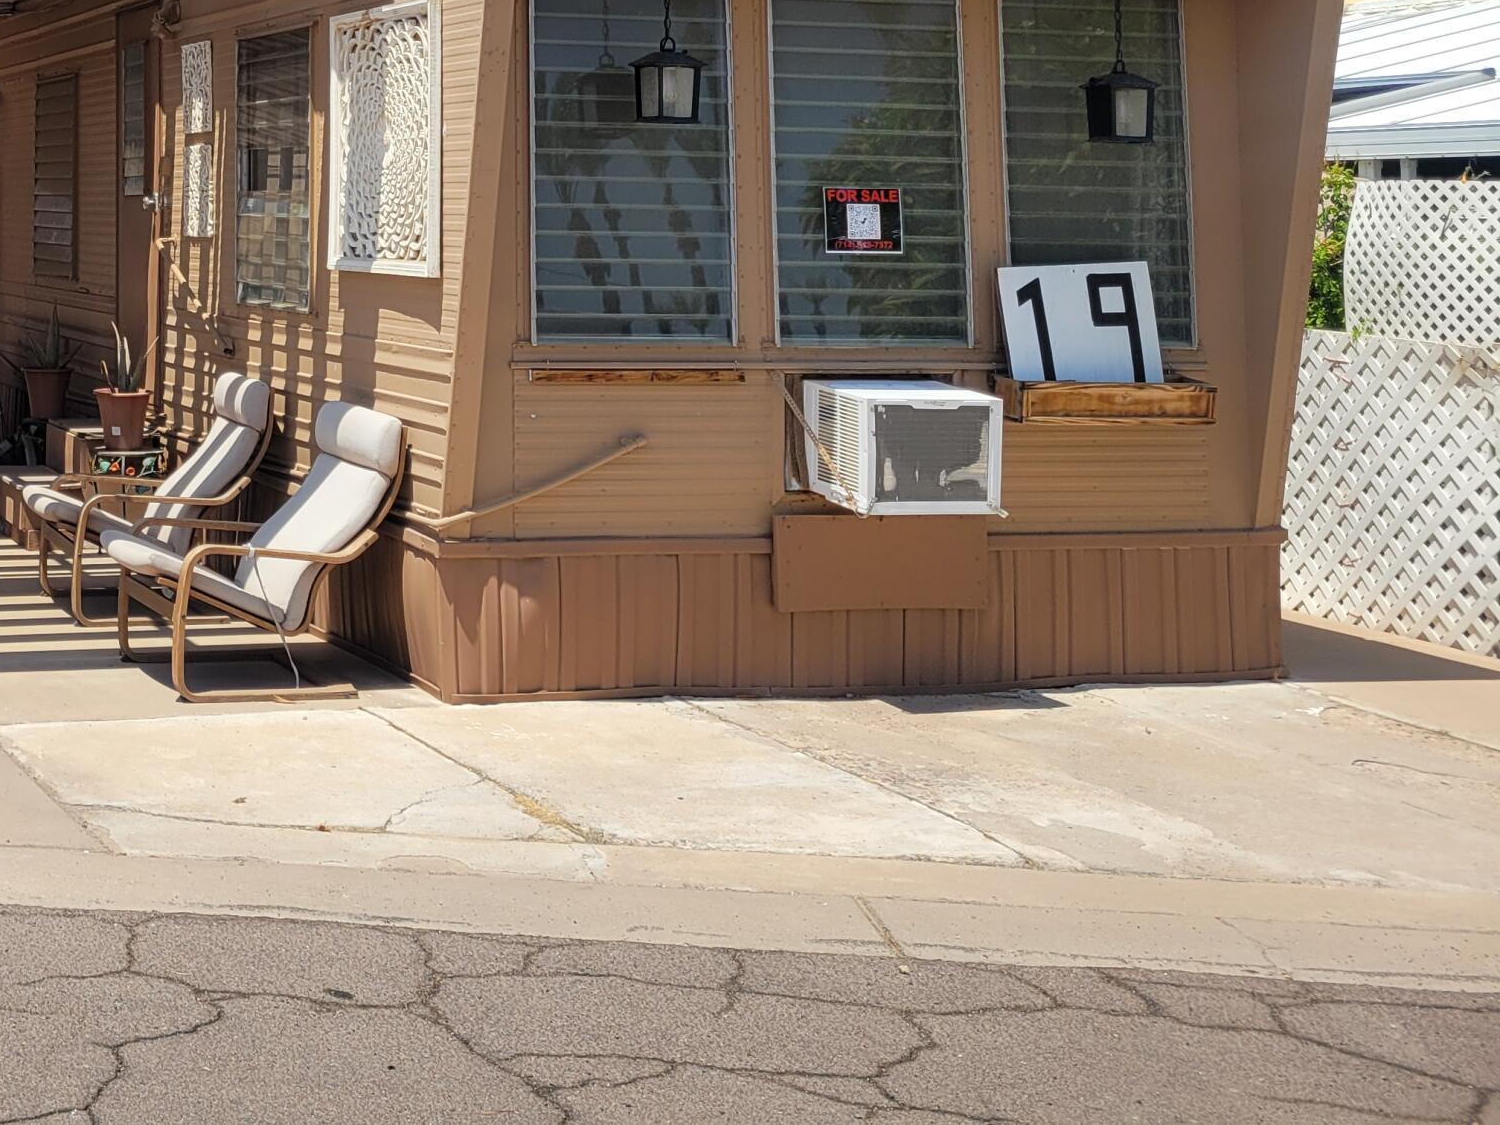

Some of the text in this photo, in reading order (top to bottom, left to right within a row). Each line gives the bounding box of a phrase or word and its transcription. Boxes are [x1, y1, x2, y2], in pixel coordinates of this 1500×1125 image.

[826, 189, 899, 203] FOR SALE
[1016, 272, 1147, 383] 19
